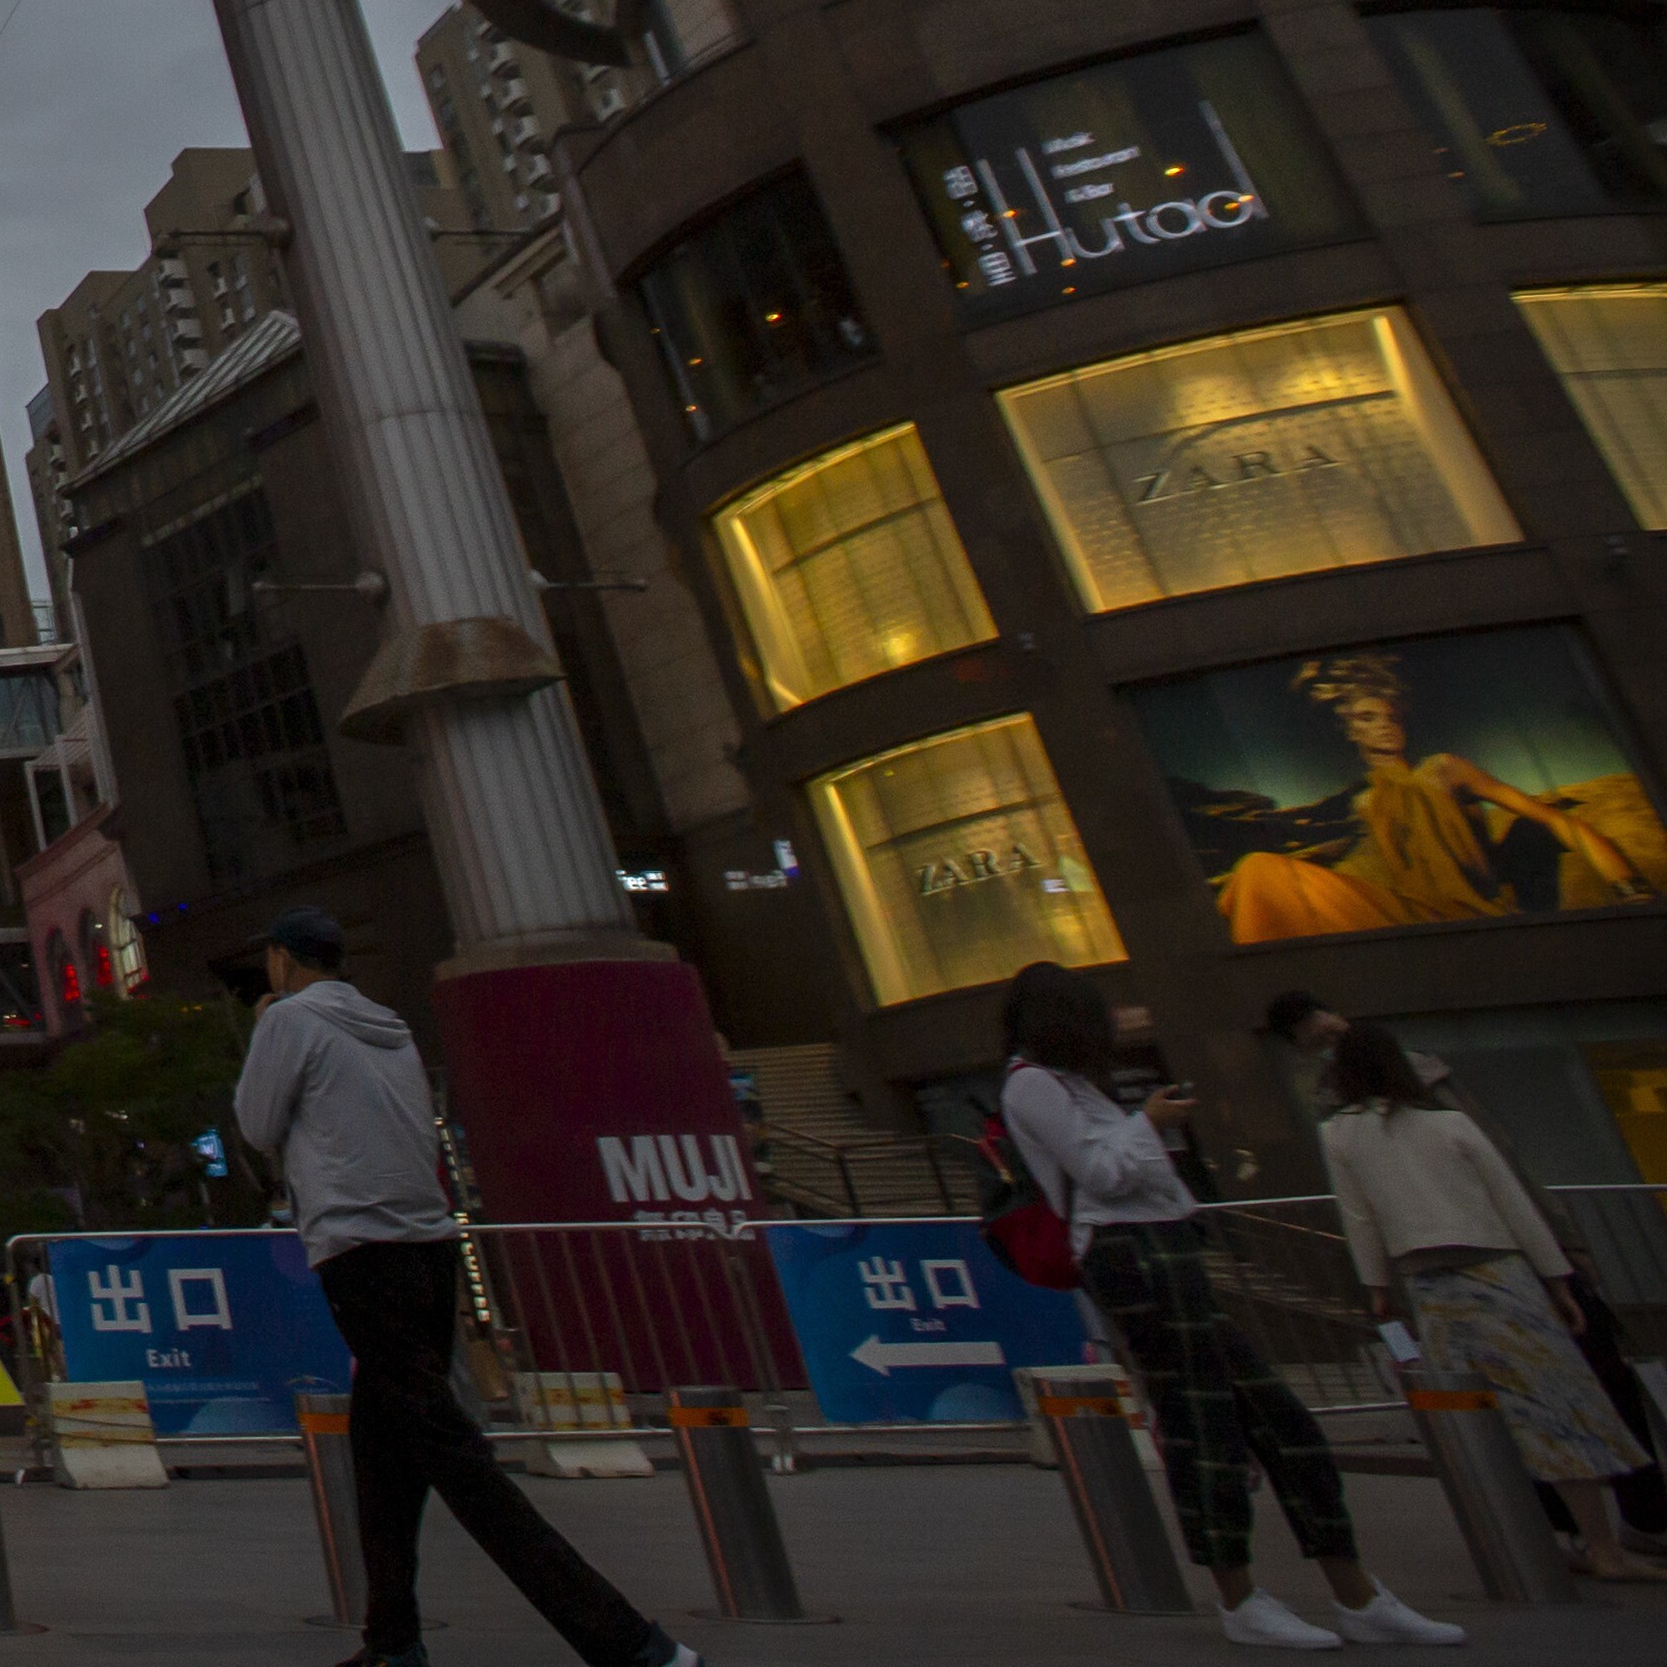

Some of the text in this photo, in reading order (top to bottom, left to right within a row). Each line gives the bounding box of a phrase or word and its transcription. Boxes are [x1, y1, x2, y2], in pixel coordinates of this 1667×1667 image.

[1133, 446, 1349, 506] ZARA
[918, 844, 1047, 897] ZARA
[596, 1134, 754, 1203] MUJI
[87, 1264, 233, 1333] 出口
[857, 1256, 981, 1311] 出口
[145, 1348, 191, 1369] Exit
